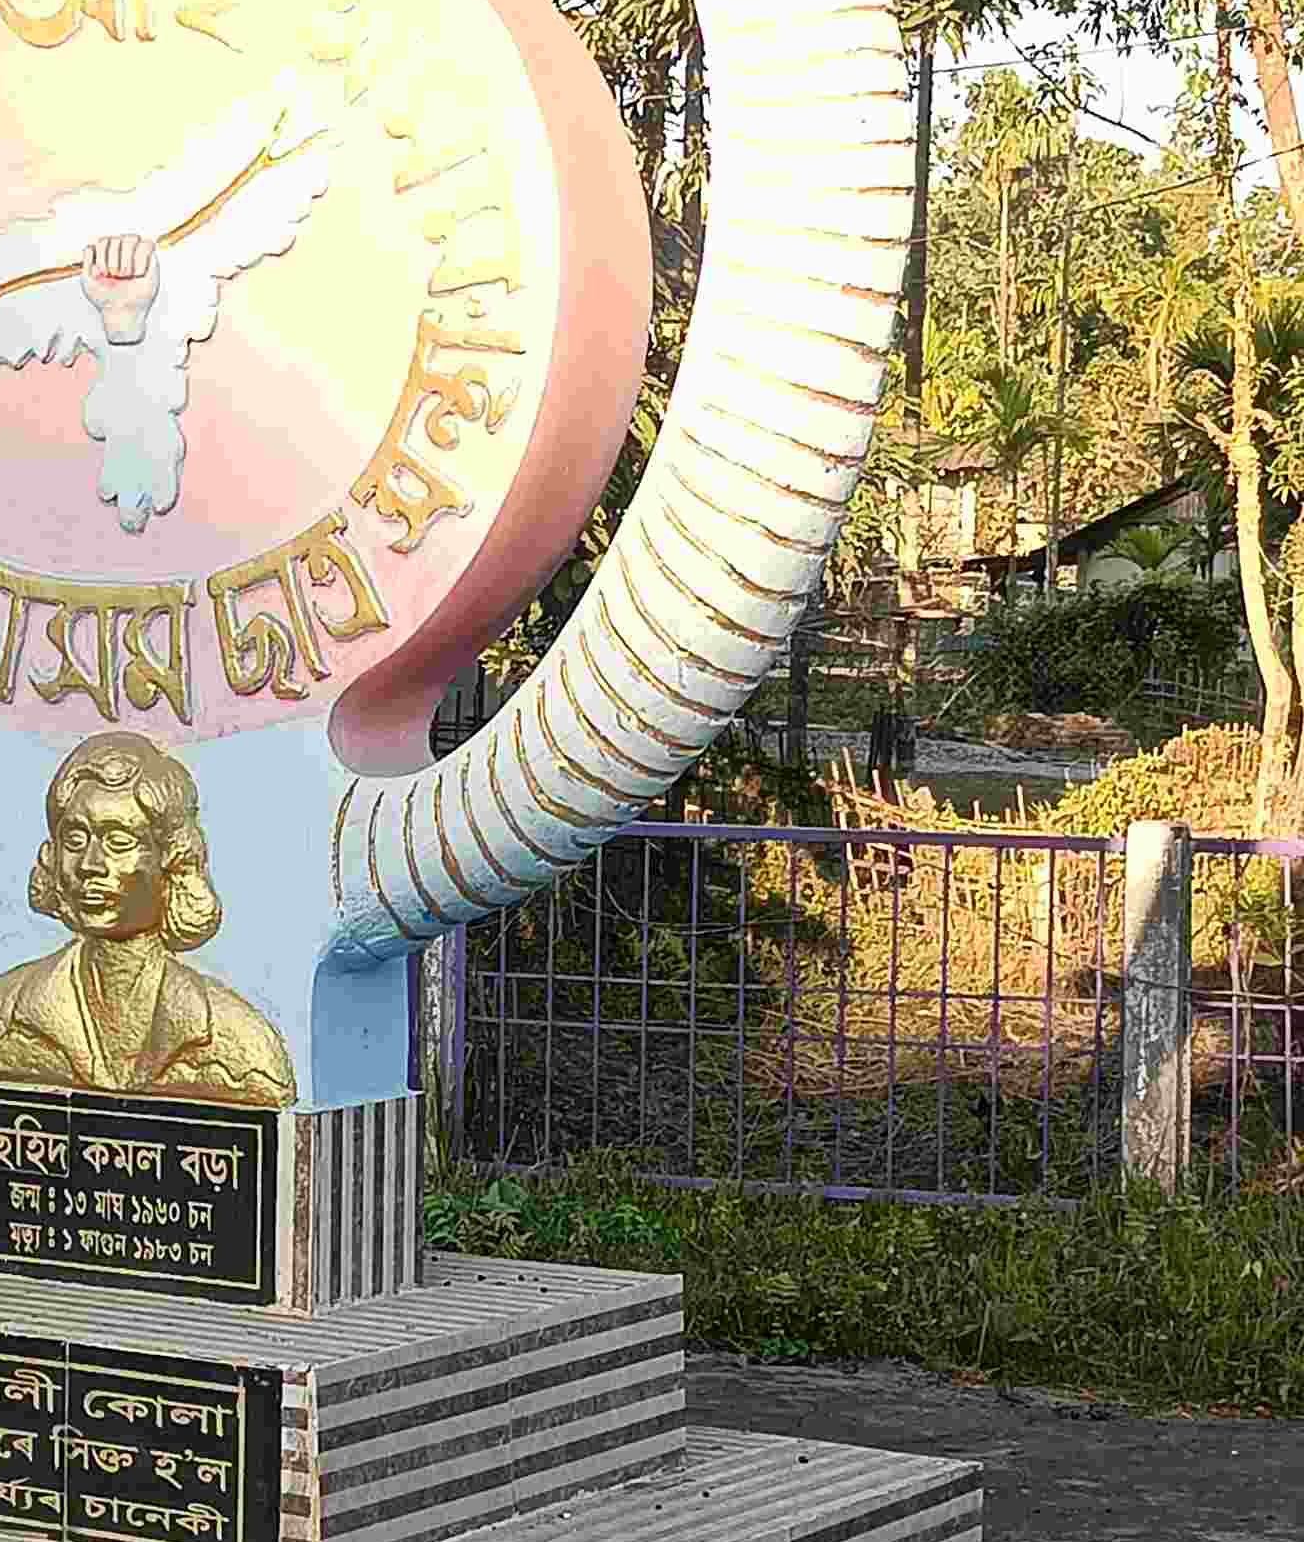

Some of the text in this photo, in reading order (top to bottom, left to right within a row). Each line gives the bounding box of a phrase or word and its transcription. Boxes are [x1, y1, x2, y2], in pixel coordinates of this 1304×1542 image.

[78, 1134, 167, 1181] কমল
[177, 1144, 245, 1193] বড়া
[63, 1188, 88, 1216] ১৩
[187, 1201, 214, 1232] চন
[133, 1235, 183, 1263] ১৯৮৩
[187, 1242, 215, 1268] চন
[83, 1389, 233, 1438] কোলা
[49, 1423, 139, 1471] সিক্ত
[80, 1493, 231, 1541] চানেকী
